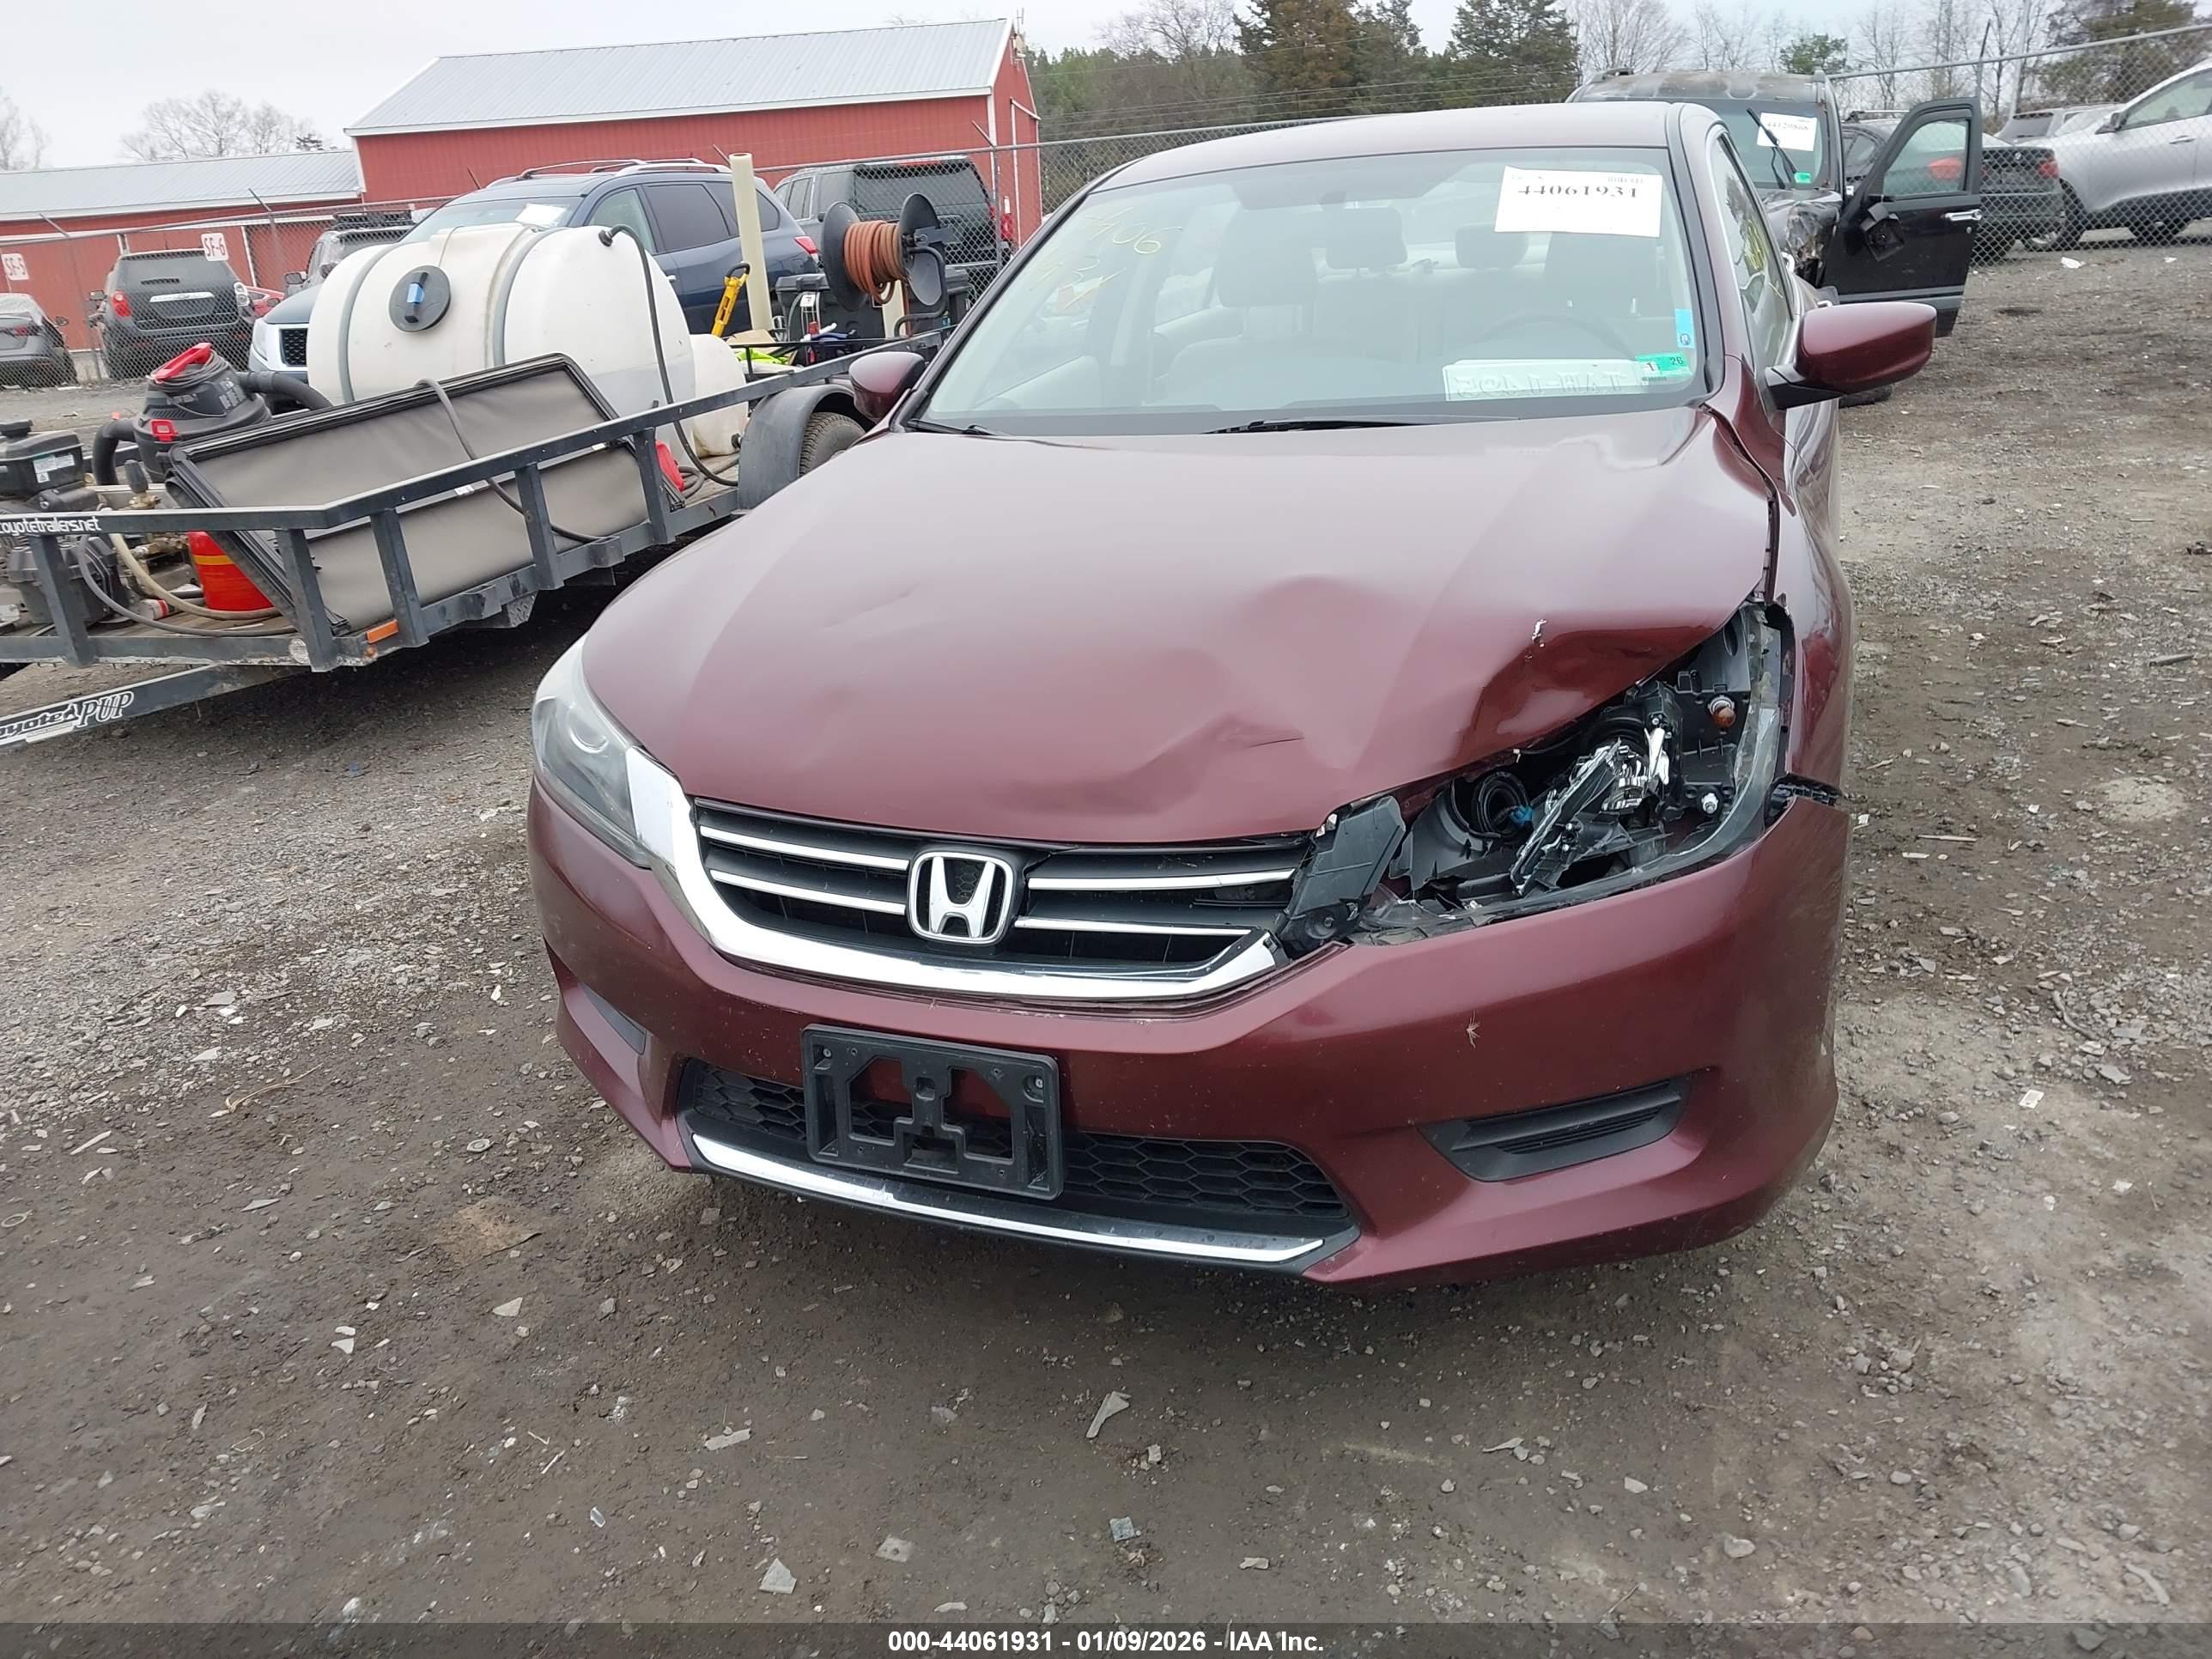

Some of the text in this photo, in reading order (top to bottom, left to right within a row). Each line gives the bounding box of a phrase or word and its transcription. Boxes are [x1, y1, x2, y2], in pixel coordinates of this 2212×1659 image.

[1517, 185, 1637, 198] 44061931
[204, 237, 226, 257] SF-6
[77, 691, 135, 727] PUP
